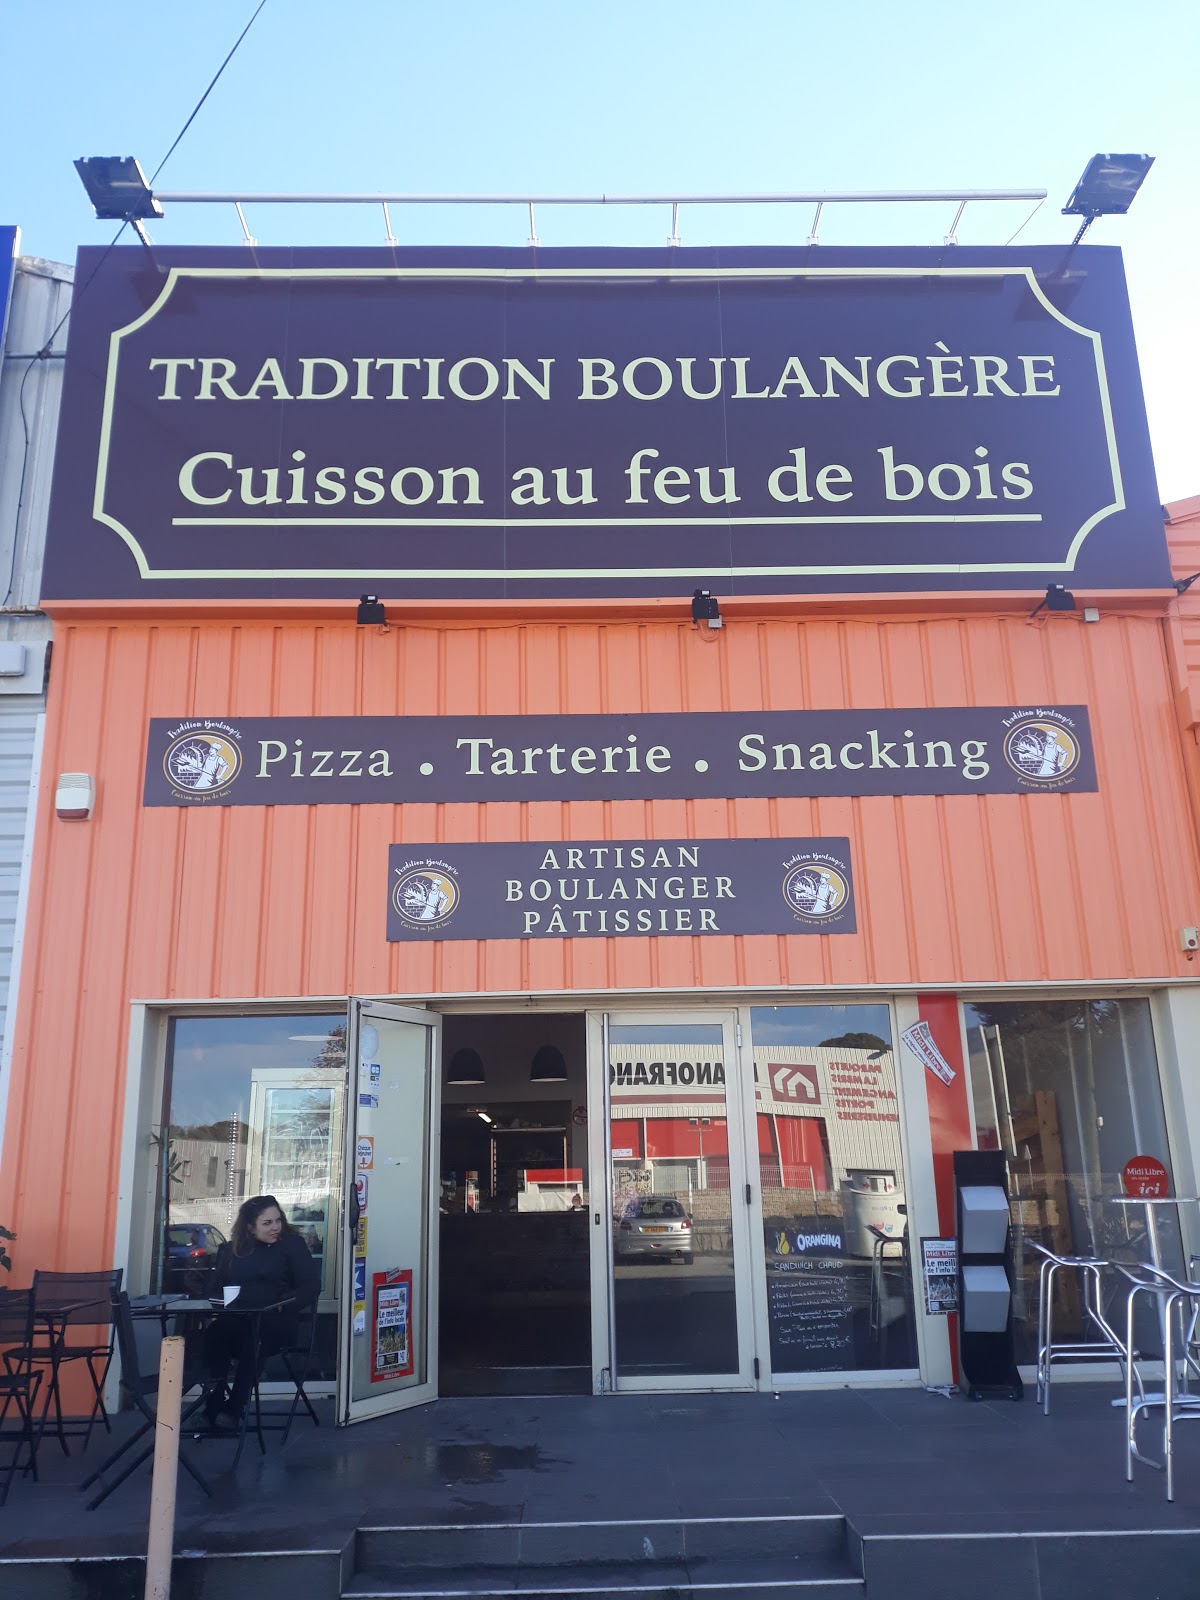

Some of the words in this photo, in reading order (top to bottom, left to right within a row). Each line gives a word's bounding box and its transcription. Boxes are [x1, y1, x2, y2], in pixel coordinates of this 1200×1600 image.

[149, 357, 556, 401] TRADITION
[577, 340, 1061, 401] BOULANGÈRE
[178, 449, 484, 506] Cuisson
[510, 466, 598, 506] au
[624, 448, 742, 505] feu
[767, 446, 854, 503] de
[877, 445, 1034, 501] bois
[255, 738, 394, 778] Pizza
[456, 734, 672, 775] Tarterie
[738, 729, 990, 780] Snacking
[539, 846, 700, 870] ARTISAN
[505, 876, 737, 902] BOULANGER
[523, 903, 720, 934] PÂTISSIER
[1144, 1168, 1165, 1176] Libre
[1139, 1183, 1160, 1195] ici
[797, 1234, 841, 1251] ORANGINA
[774, 1260, 813, 1272] SANDWICH
[818, 1261, 843, 1269] CHAUD
[926, 1259, 935, 1267] Le
[937, 1259, 956, 1267] meill
[379, 1310, 385, 1319] Le
[386, 1308, 404, 1317] meilleur
